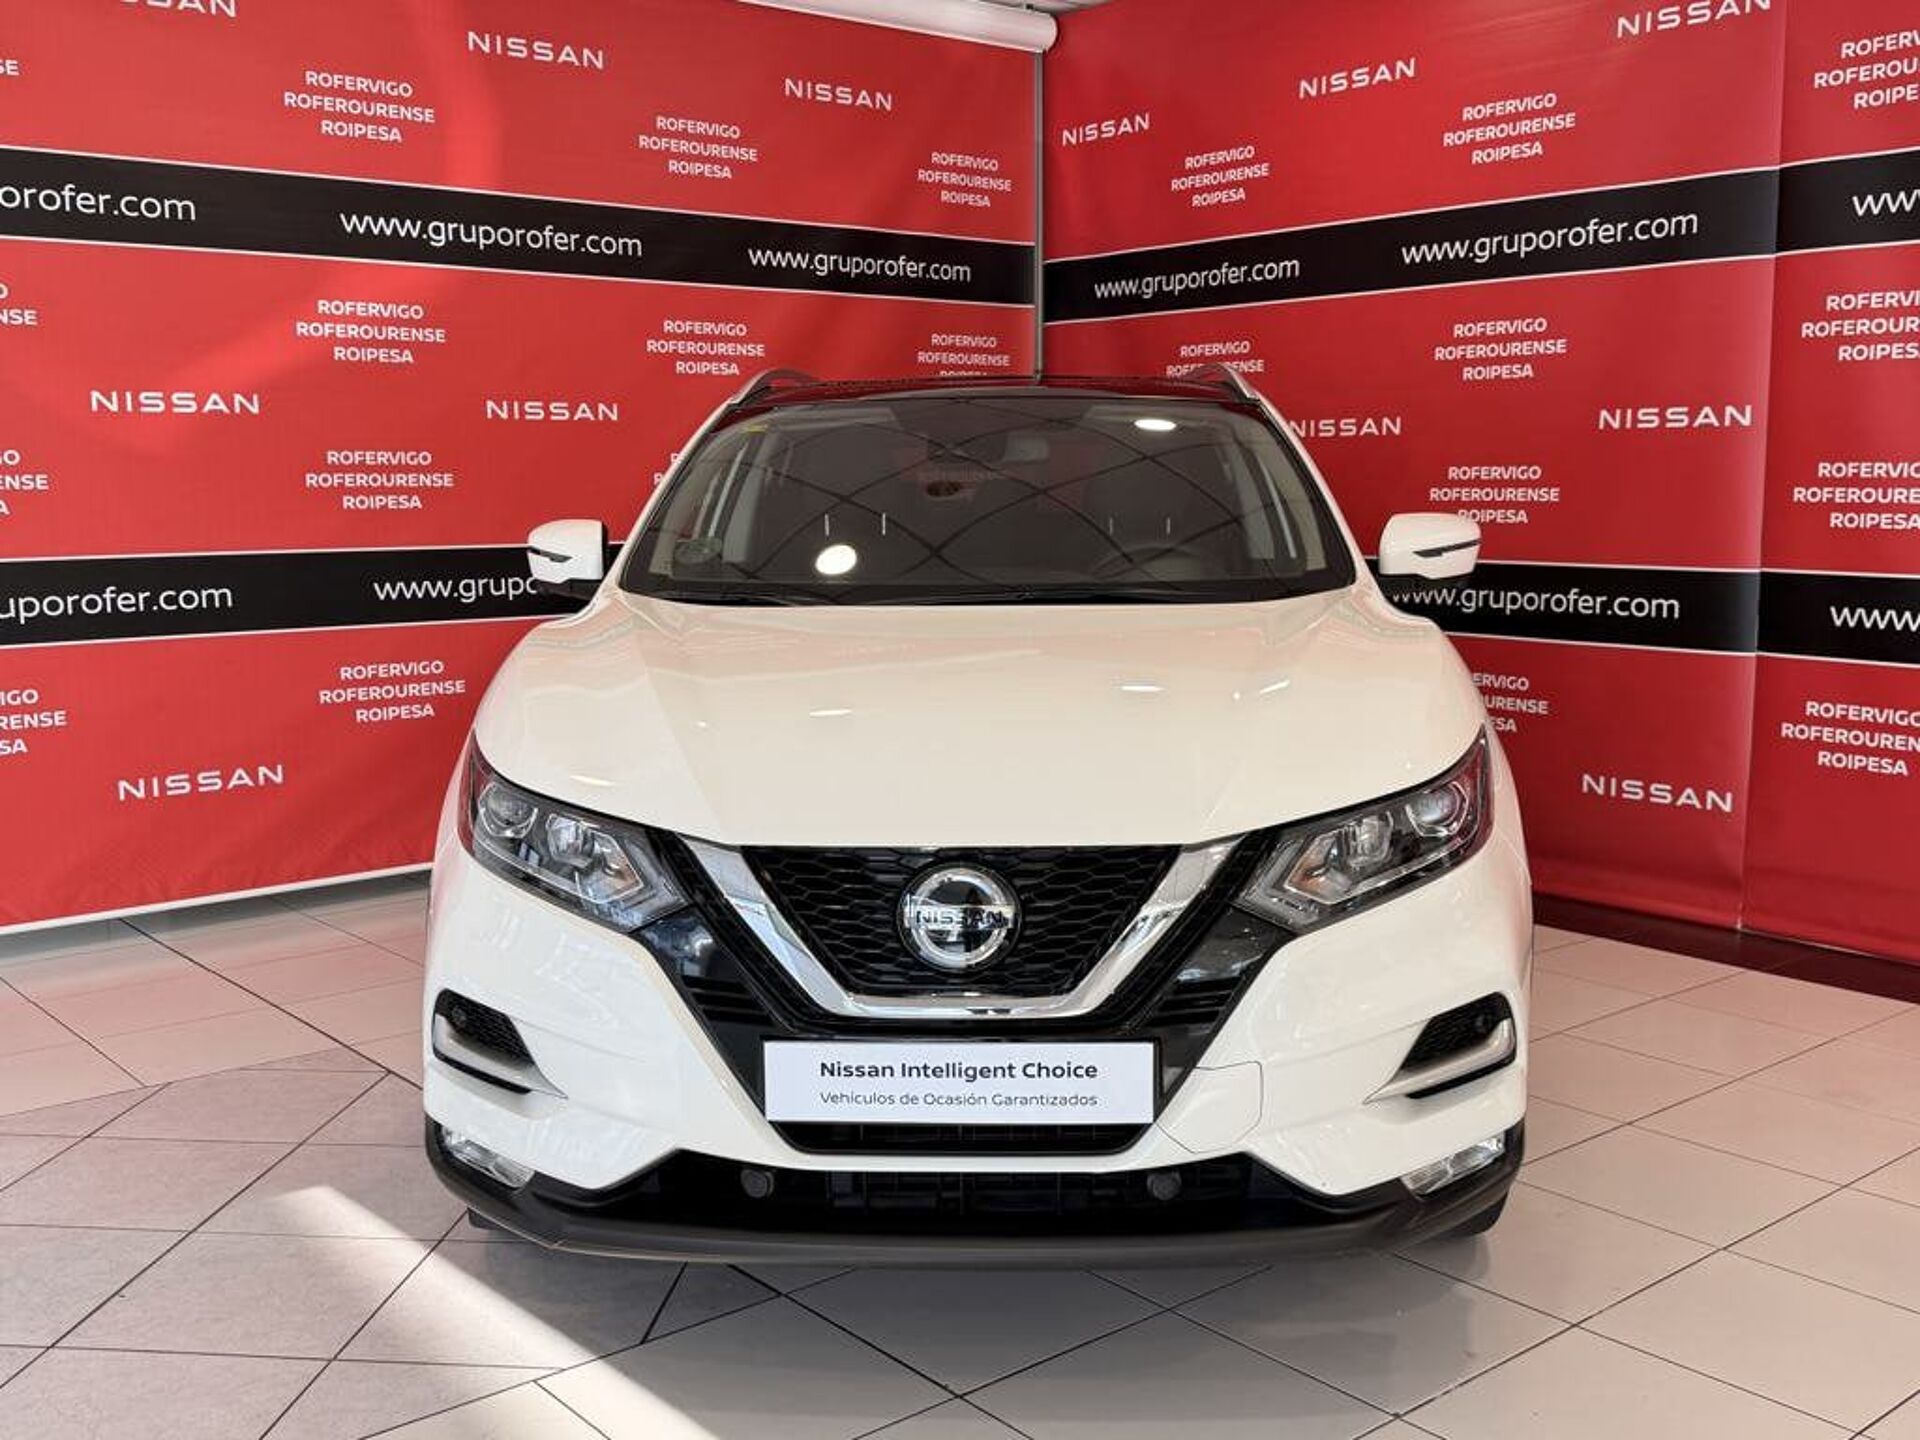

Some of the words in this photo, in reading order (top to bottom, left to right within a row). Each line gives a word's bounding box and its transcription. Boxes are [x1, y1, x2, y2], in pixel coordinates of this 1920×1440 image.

[468, 32, 603, 69] NISSAN
[1300, 58, 1415, 98] NISSAN
[1815, 57, 1920, 88] ROFEROU
[306, 71, 412, 97] ROFERVIGO
[785, 78, 891, 110] NISSAN
[284, 92, 434, 122] ROFEROURENSE
[1463, 93, 1556, 120] ROFERVIGO
[321, 120, 401, 142] ROIPESA
[656, 116, 740, 139] ROFERVIGO
[1063, 113, 1149, 146] NISSAN
[1444, 113, 1575, 146] ROFEROURENSE
[639, 135, 757, 161] ROFEROURENSE
[1185, 146, 1255, 169] ROFERVIGO
[1472, 141, 1543, 164] ROIPESA
[669, 160, 731, 178] ROIPESA
[932, 152, 998, 171] ROFERVIGO
[918, 169, 1011, 191] ROFEROURENSE
[1172, 163, 1269, 190] ROFEROURENSE
[0, 184, 195, 220] orofer.com
[940, 189, 991, 208] ROIPESA
[1192, 188, 1245, 206] ROIPESA
[340, 214, 641, 256] www.gruporofer.com
[1402, 214, 1697, 264] www.gruporofer.com
[748, 249, 970, 281] www.gruporofer.com
[1095, 260, 1299, 298] www.gruporofer.com
[318, 300, 423, 319] ROFERVIGO
[296, 322, 445, 342] ROFEROURENSE
[663, 319, 748, 337] ROFERVIGO
[1454, 318, 1547, 337] ROFERVIGO
[646, 339, 765, 357] ROFEROURENSE
[931, 333, 997, 348] ROFERVIGO
[1180, 340, 1251, 358] ROFERVIGO
[1435, 339, 1566, 360] ROFEROURENSE
[1838, 342, 1920, 361] ROIPES
[333, 346, 414, 363] ROIPESA
[917, 351, 1010, 367] ROFEROURENSE
[675, 360, 740, 376] ROIPESA
[1462, 363, 1534, 381] ROIPESA
[91, 391, 259, 413] NISSAN
[487, 400, 617, 420] NISSAN
[1289, 416, 1401, 438] NISSAN
[1599, 405, 1751, 429] NISSAN
[326, 450, 432, 466] ROFERVIGO
[305, 472, 454, 488] ROFEROURENSE
[1448, 465, 1542, 481] ROFERVIGO
[342, 494, 423, 510] ROIPESA
[1429, 487, 1560, 502] ROFEROURENSE
[340, 660, 444, 680] ROFERVIGO
[319, 680, 465, 703] ROFEROURENSE
[356, 704, 434, 722] ROIPESA
[1818, 751, 1908, 775] ROIPESA
[118, 765, 283, 800] NISSAN
[1583, 774, 1732, 812] NISSAN
[915, 908, 1004, 926] NISSAN
[820, 1060, 895, 1078] Nissan
[902, 1062, 1016, 1082] Intelligent
[1021, 1061, 1098, 1079] Choice
[900, 1094, 917, 1105] de
[922, 1092, 988, 1107] Ocasión
[991, 1093, 1098, 1107] Garantizados
